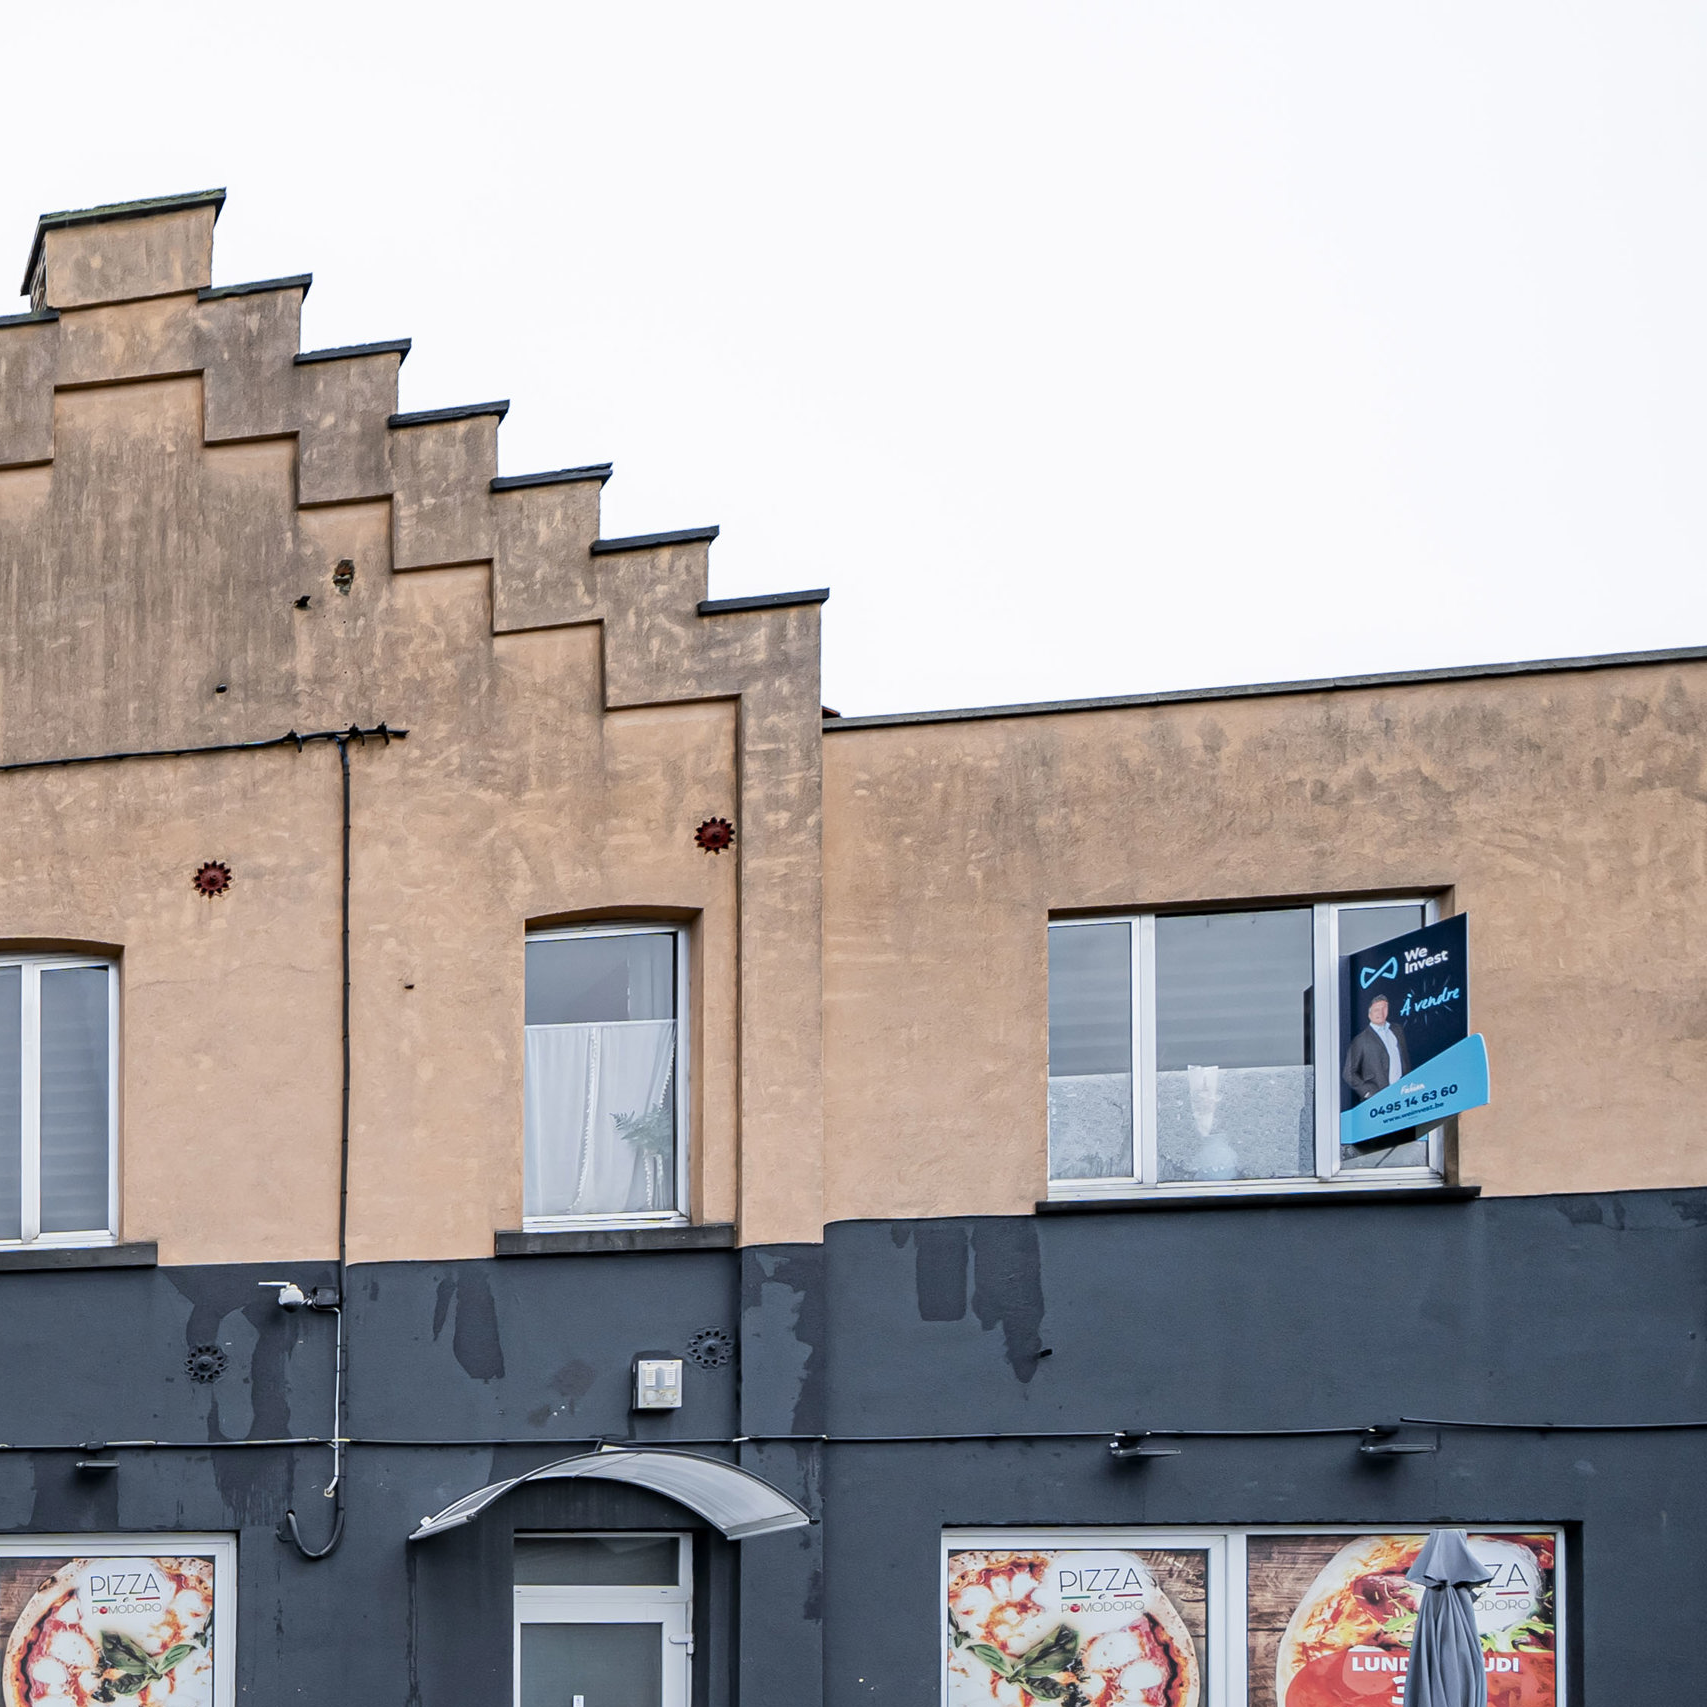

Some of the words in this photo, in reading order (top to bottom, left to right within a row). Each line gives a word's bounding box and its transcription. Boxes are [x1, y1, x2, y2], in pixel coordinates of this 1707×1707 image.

[1404, 947, 1428, 962] We
[1404, 950, 1448, 974] Invest
[1415, 987, 1459, 1012] vendre
[1370, 1101, 1401, 1118] 0495
[1404, 1096, 1418, 1108] 14
[1421, 1090, 1437, 1102] 63
[1440, 1084, 1458, 1097] 60
[1383, 1102, 1444, 1123] www.weinvest.be
[90, 1572, 160, 1596] PIZZA
[1059, 1568, 1142, 1592] PIZZA
[1061, 1600, 1145, 1614] POMODORO
[1473, 1599, 1531, 1612] ODORO
[1352, 1656, 1409, 1672] LUND
[1484, 1657, 1520, 1672] UDI
